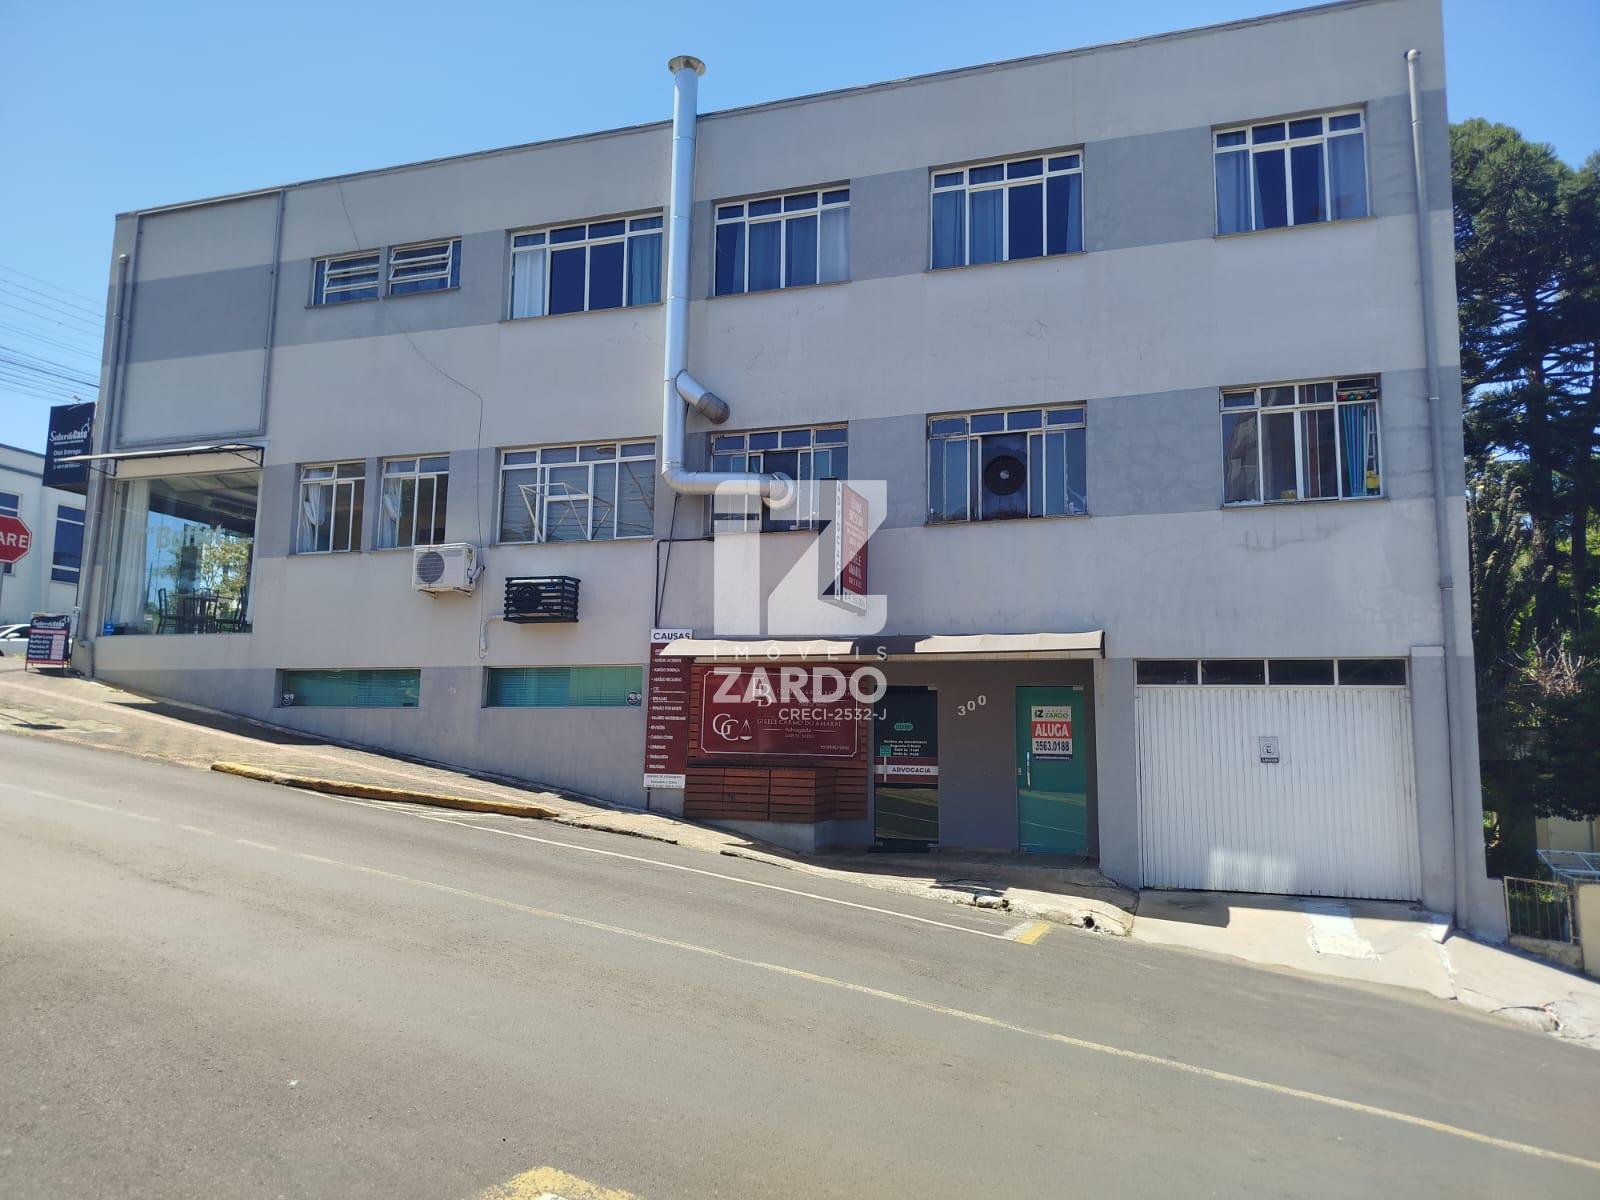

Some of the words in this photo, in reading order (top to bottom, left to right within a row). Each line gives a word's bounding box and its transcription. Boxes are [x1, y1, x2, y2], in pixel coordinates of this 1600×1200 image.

[653, 632, 690, 640] CAUSAS
[957, 695, 987, 716] 300
[1034, 723, 1069, 737] ALUGA
